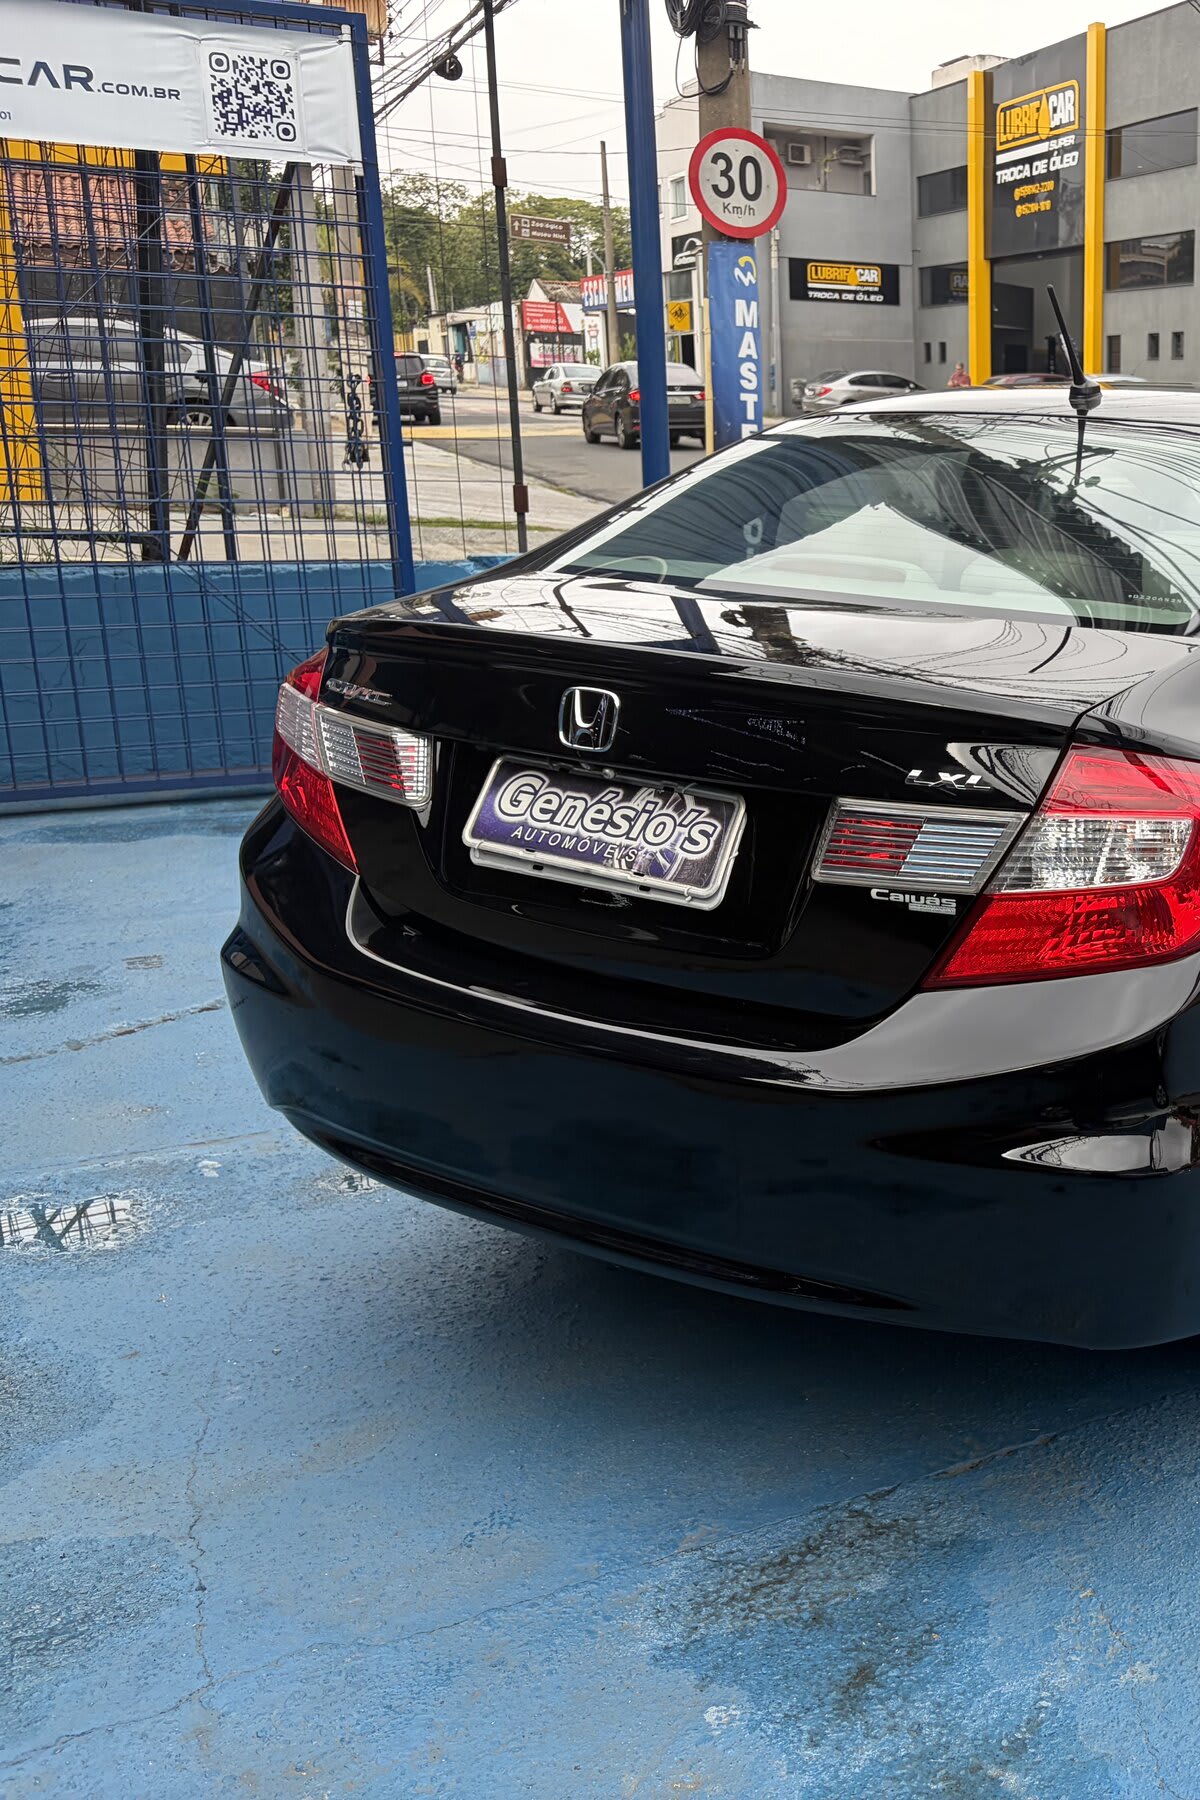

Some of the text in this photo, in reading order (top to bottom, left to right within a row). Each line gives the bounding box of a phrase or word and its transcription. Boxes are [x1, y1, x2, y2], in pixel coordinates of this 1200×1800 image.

[1048, 134, 1076, 151] SUPER
[710, 152, 762, 202] 30
[996, 151, 1079, 185] TROCA DE ÓLEO
[722, 202, 756, 217] Km/h
[808, 291, 884, 302] TROCA DE ÓLEO
[497, 772, 722, 857] Genésio's
[511, 825, 638, 862] AUTOMÓVEIS
